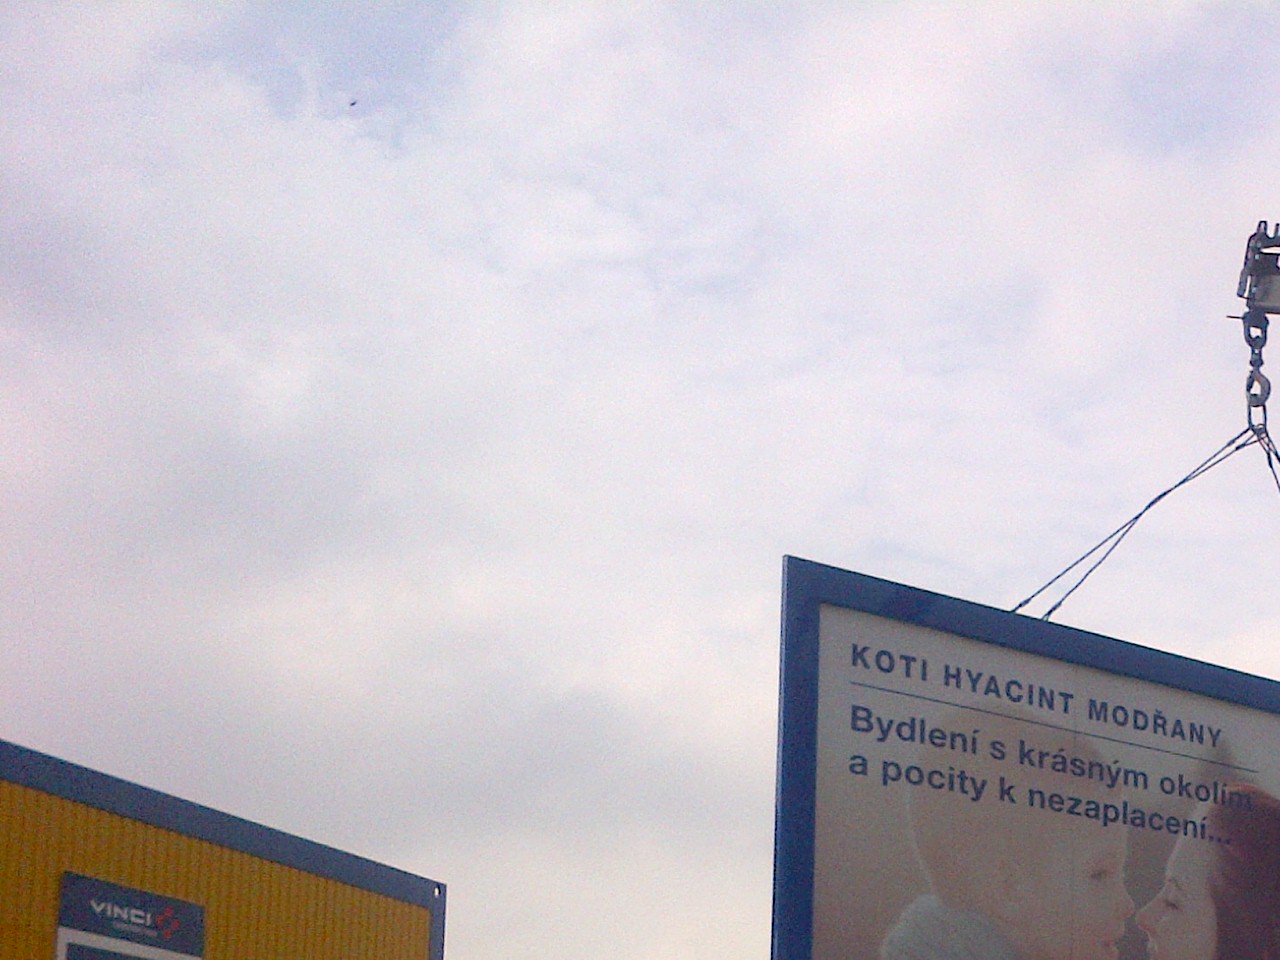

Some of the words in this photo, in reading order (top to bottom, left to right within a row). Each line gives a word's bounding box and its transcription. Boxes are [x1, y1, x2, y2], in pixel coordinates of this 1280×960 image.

[852, 643, 928, 682] KOTI
[943, 665, 1074, 714] HYACINT
[1088, 699, 1222, 747] MODŘANY
[850, 705, 981, 754] Bydlení
[988, 739, 1006, 760] s
[1018, 739, 1148, 789] krásným
[848, 754, 868, 776] a
[882, 760, 988, 800] pocity
[998, 776, 1017, 804] k
[1028, 788, 1231, 845] nezaplacení...
